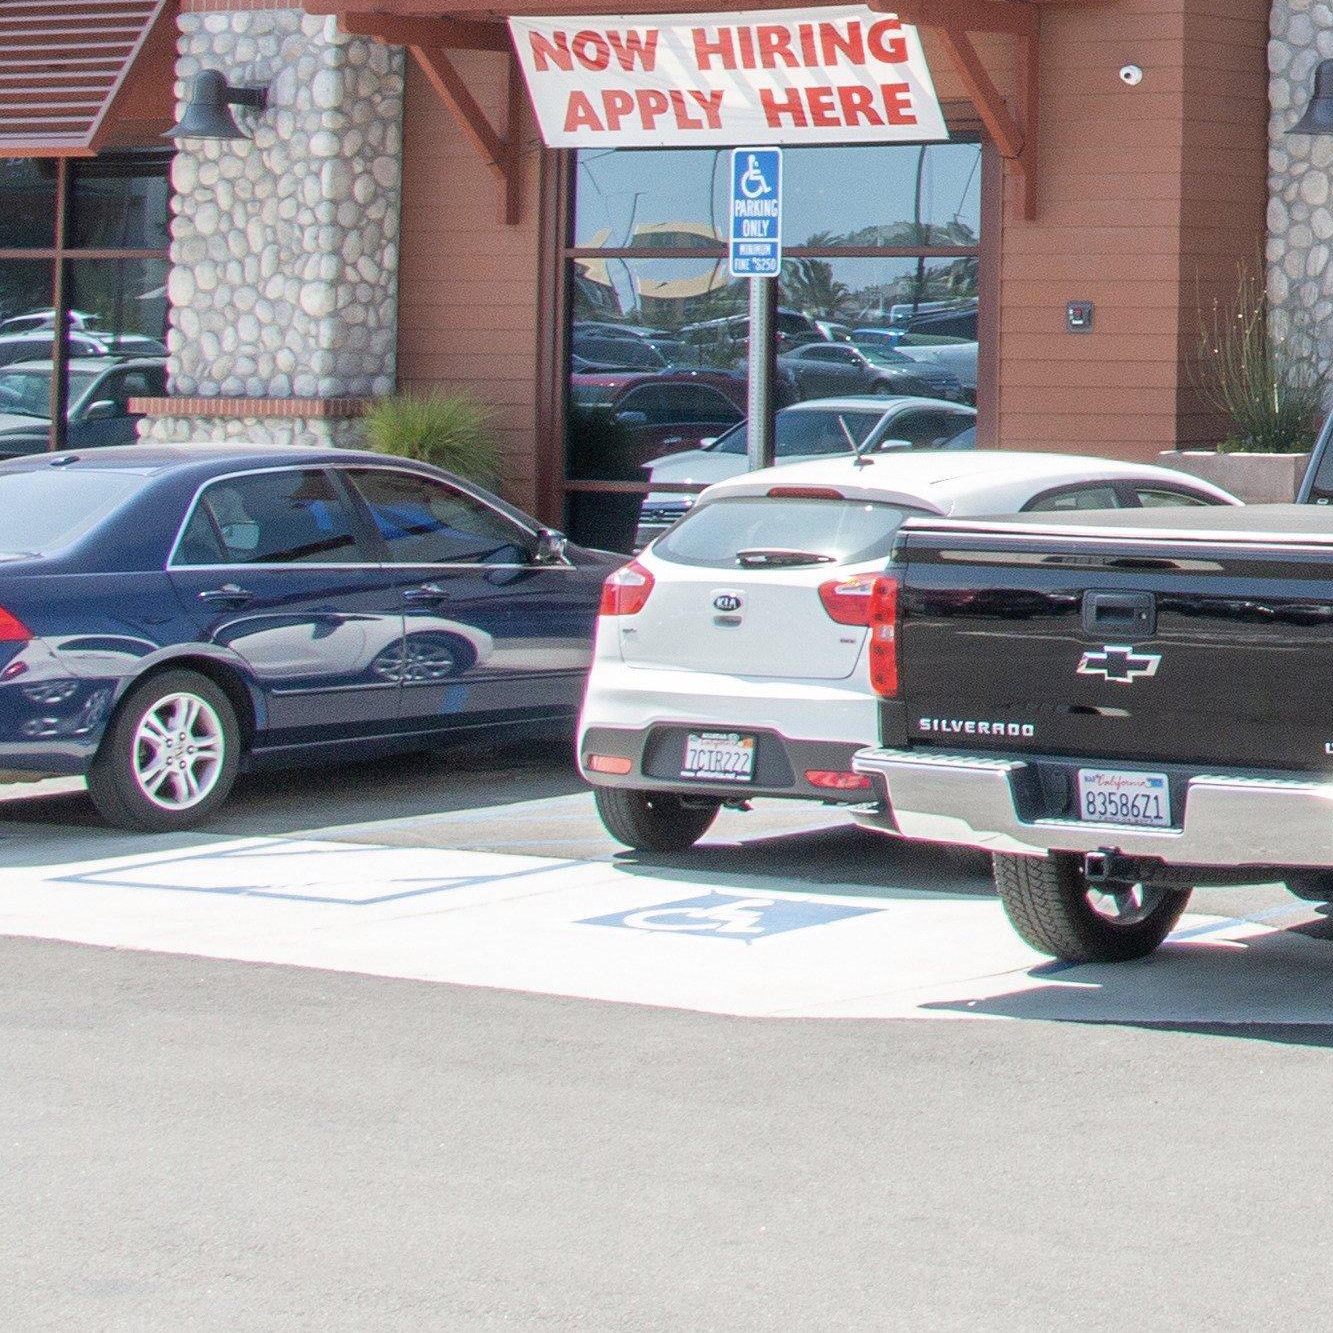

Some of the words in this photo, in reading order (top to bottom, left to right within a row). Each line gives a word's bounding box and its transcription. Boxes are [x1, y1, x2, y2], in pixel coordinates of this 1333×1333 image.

[529, 29, 659, 72] NOW
[692, 19, 909, 71] HIRING
[563, 90, 725, 132] APPLY
[759, 83, 918, 128] HERE
[735, 199, 778, 217] PARKING
[742, 219, 770, 237] ONLY
[716, 597, 740, 609] KIA
[919, 718, 1035, 737] SILVERADO
[1095, 773, 1147, 790] California
[1085, 791, 1164, 819] 83586Z1
